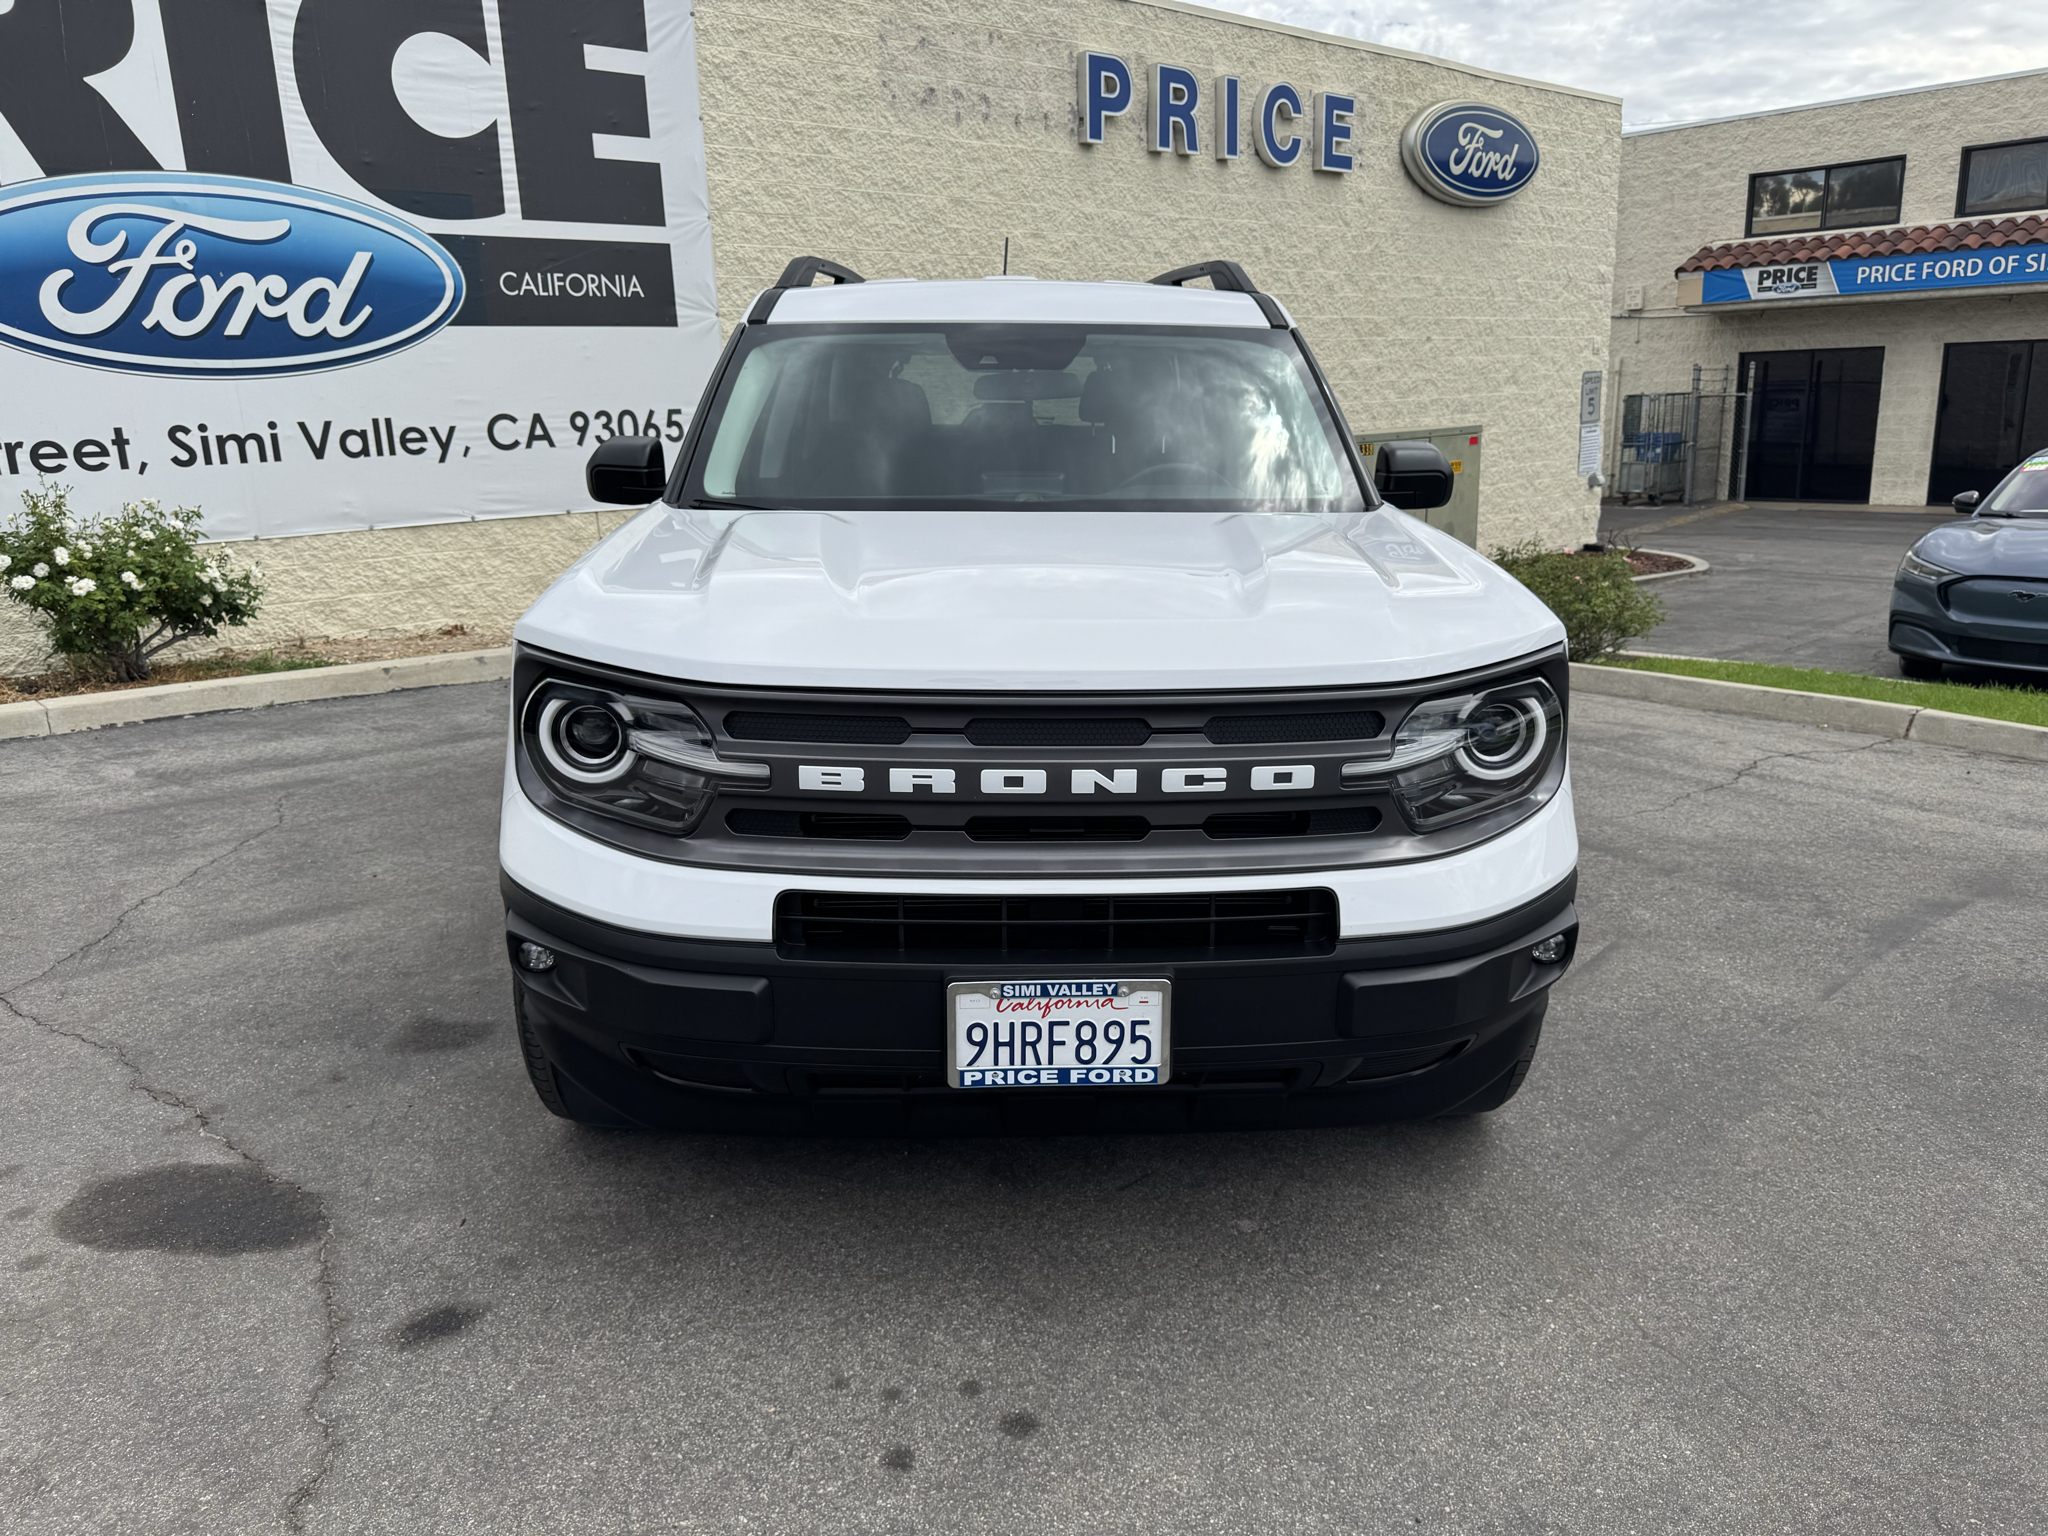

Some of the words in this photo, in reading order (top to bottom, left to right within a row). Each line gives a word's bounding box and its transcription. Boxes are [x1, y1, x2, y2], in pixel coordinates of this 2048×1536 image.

[1079, 50, 1356, 173] PRICE
[1449, 121, 1520, 182] Ford
[38, 202, 374, 339] Ford
[1758, 265, 1819, 286] PRICE
[1857, 262, 1917, 284] PRICE
[1921, 258, 1983, 280] FORD
[1988, 254, 2020, 275] OF
[2025, 252, 2048, 273] SI
[499, 271, 645, 298] CALIFORNIA
[1587, 397, 1596, 415] 5
[0, 427, 148, 476] reet,
[168, 420, 282, 468] Simi
[297, 417, 471, 464] Valley,
[487, 413, 556, 451] CA
[569, 408, 685, 447] 93065
[799, 765, 1316, 794] BRONCO
[1002, 984, 1041, 997] SIMI
[1047, 983, 1117, 996] VALLEY
[996, 997, 1129, 1019] California
[966, 1019, 1152, 1067] 9HRF895
[963, 1069, 1059, 1086] PRICE
[1070, 1068, 1155, 1084] FORD
